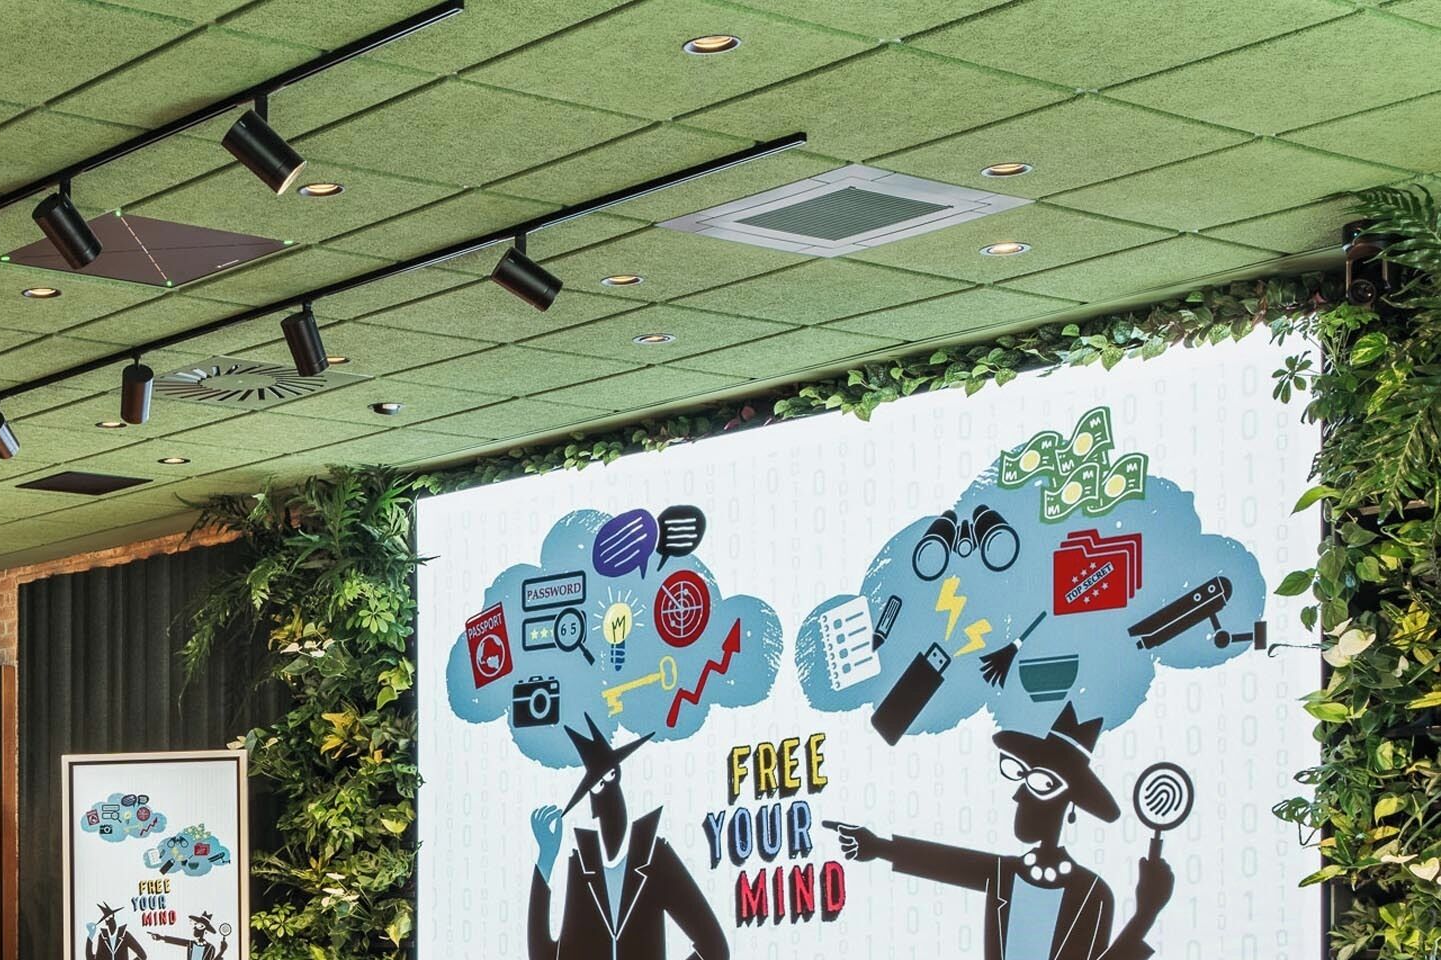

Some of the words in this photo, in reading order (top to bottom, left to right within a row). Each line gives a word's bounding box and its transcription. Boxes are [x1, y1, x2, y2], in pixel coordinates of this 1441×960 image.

[527, 582, 581, 600] PASSWORD
[1067, 586, 1082, 600] TOP
[1083, 563, 1111, 589] SECRET
[468, 613, 502, 639] PASSPORT
[727, 732, 829, 806] FREE
[702, 800, 813, 870] YOUR
[131, 895, 167, 912] YOUR
[735, 860, 846, 928] MIND
[141, 910, 177, 927] MIND
